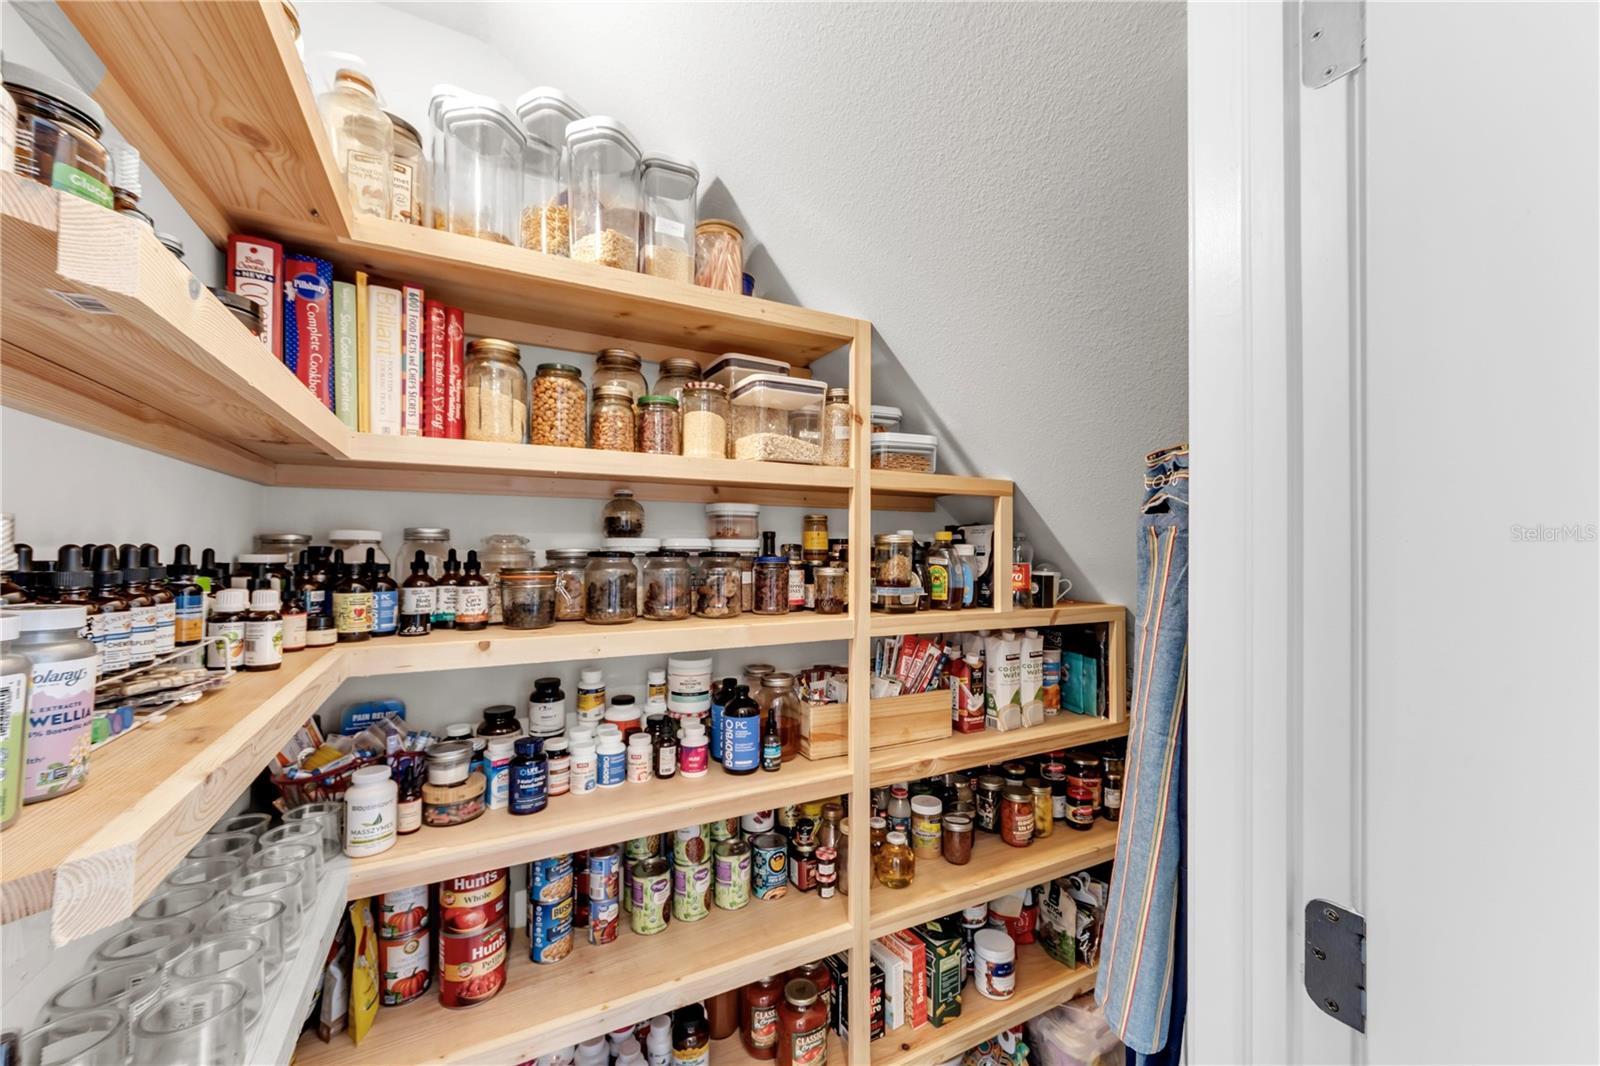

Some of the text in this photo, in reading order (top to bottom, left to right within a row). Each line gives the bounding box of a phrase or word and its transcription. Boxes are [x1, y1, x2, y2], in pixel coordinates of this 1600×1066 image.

[242, 271, 266, 280] NEW
[376, 291, 398, 356] Brilliant
[408, 314, 418, 333] FOOD
[306, 302, 323, 401] Complete Cookbo
[408, 334, 419, 354] FACTS
[341, 371, 353, 412] Favorites
[408, 391, 419, 418] SECRETS
[32, 668, 88, 687] olaray
[735, 721, 748, 730] PC
[724, 719, 735, 768] BODYBIO
[464, 891, 492, 904] Whole
